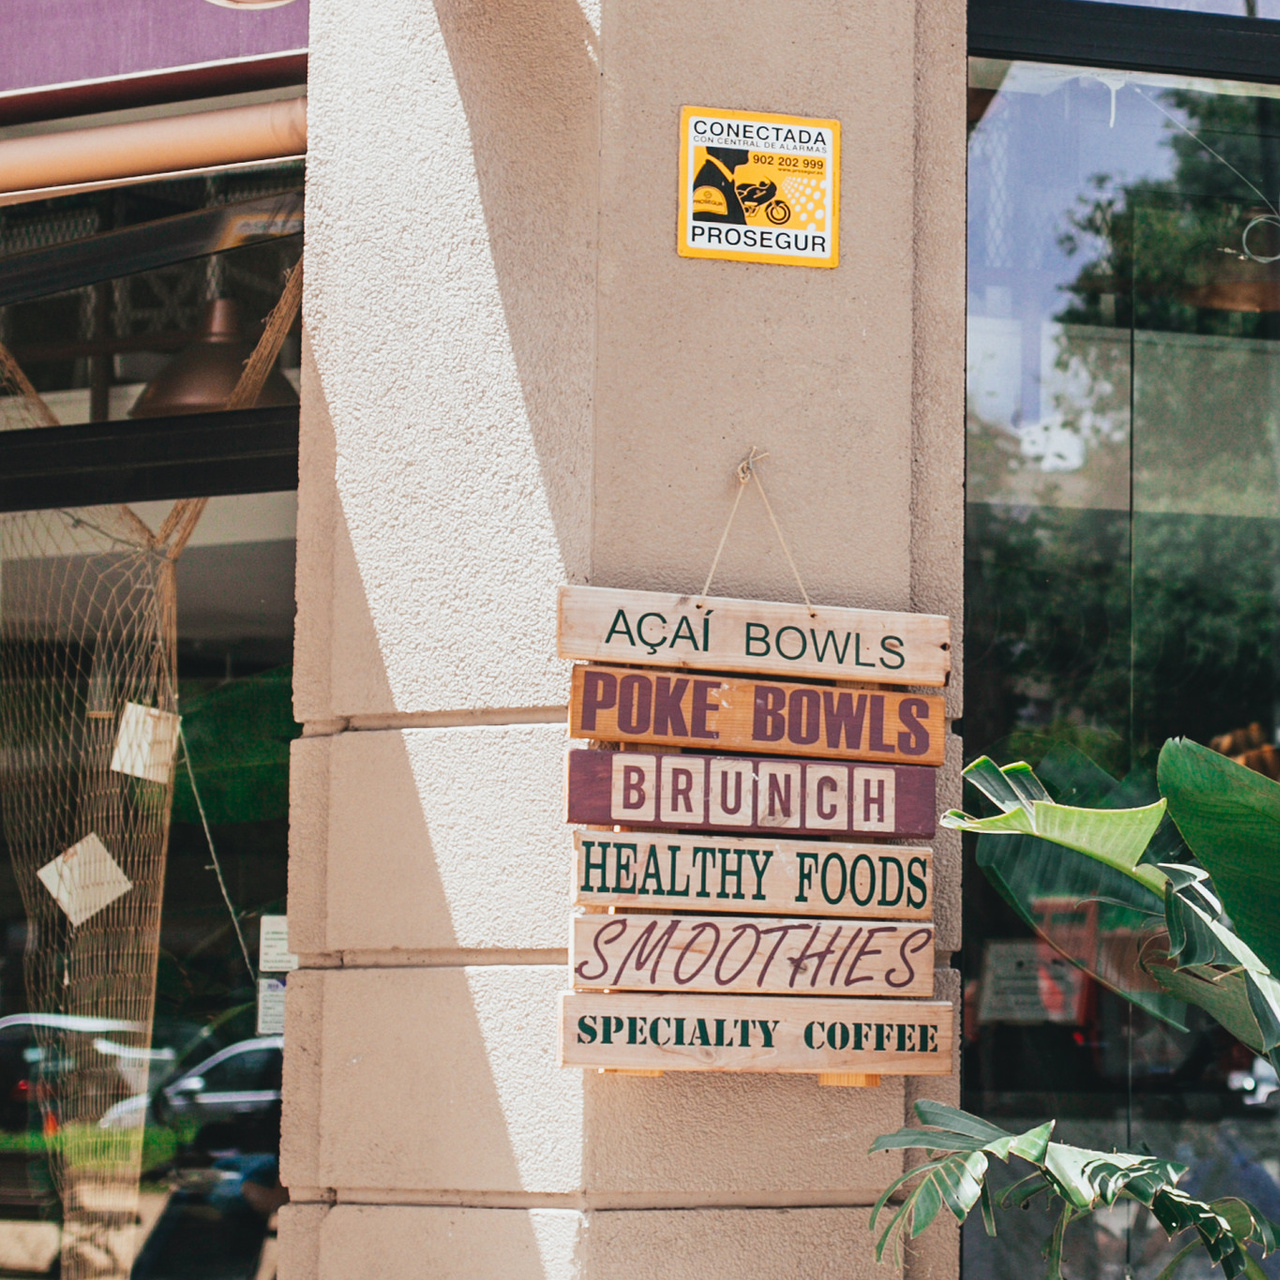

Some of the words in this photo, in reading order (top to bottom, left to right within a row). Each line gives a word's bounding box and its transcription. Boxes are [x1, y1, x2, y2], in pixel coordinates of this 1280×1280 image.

[693, 135, 714, 144] CON
[717, 137, 760, 148] CENTRAL
[764, 141, 776, 149] DE
[780, 144, 828, 154] ALARMAS
[694, 120, 826, 146] CONECTADA
[753, 154, 774, 166] 902
[778, 157, 799, 168] 202
[803, 159, 824, 170] 999
[691, 225, 826, 252] PROSEGUR
[604, 608, 714, 655] AÇAÍ
[745, 622, 906, 670] BOWLS
[580, 670, 722, 740] POKE
[752, 684, 931, 756] BOWLS
[622, 766, 885, 824] BRUNCH
[580, 840, 773, 902] HEALTHY
[795, 852, 928, 910] FOODS
[575, 919, 933, 988] SMOOTHIES
[577, 1015, 780, 1049] SPECIALTY
[803, 1020, 939, 1053] COFFEE
